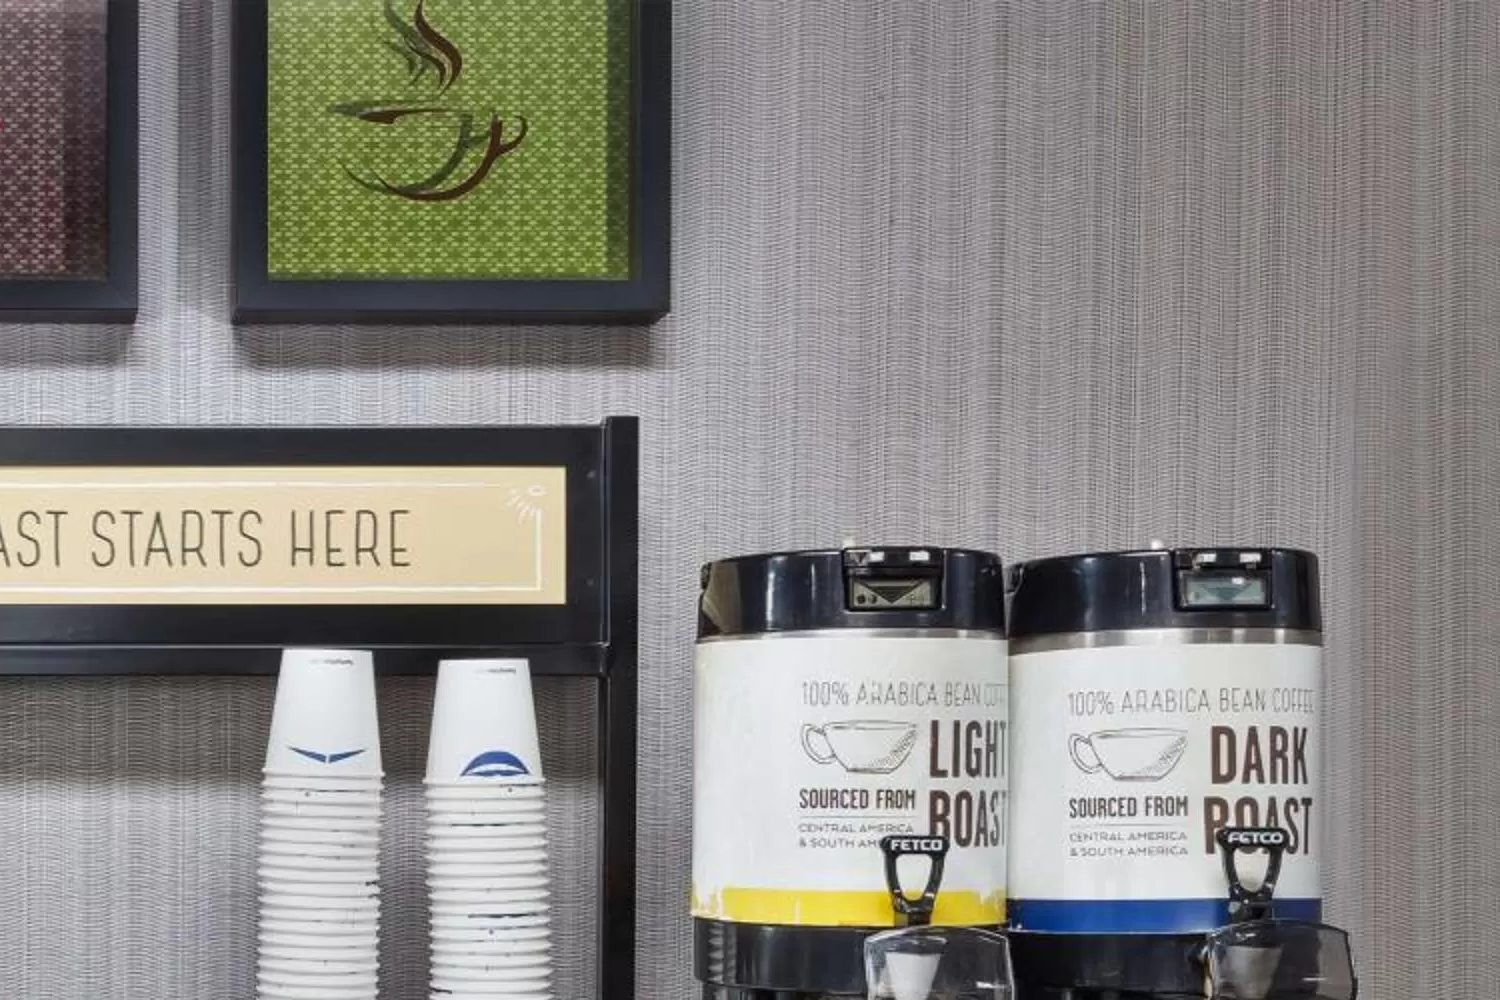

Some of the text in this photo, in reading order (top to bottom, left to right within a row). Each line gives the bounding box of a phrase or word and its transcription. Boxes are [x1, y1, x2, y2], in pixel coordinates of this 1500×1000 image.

[91, 509, 263, 568] STARTS
[290, 509, 411, 568] HERE
[802, 681, 850, 706] 100%
[855, 681, 938, 706] ARABICA
[944, 682, 980, 707] BEAN
[1068, 688, 1315, 716] 100% ARABICA BEAN COFFEE
[929, 720, 1007, 779] LIGHT
[1210, 725, 1309, 785] DARK
[799, 788, 916, 811] SOURCED FROM
[1069, 795, 1189, 819] SOURCED FROM
[929, 789, 1007, 848] ROAST
[1203, 795, 1313, 855] ROAST
[810, 838, 856, 848] SOUTH
[890, 839, 943, 851] FETCO
[1069, 831, 1188, 842] CENTRAL AMERICA
[1227, 833, 1284, 845] FETCO
[1079, 847, 1125, 857] SOUTH
[1127, 847, 1189, 857] AMERICA
